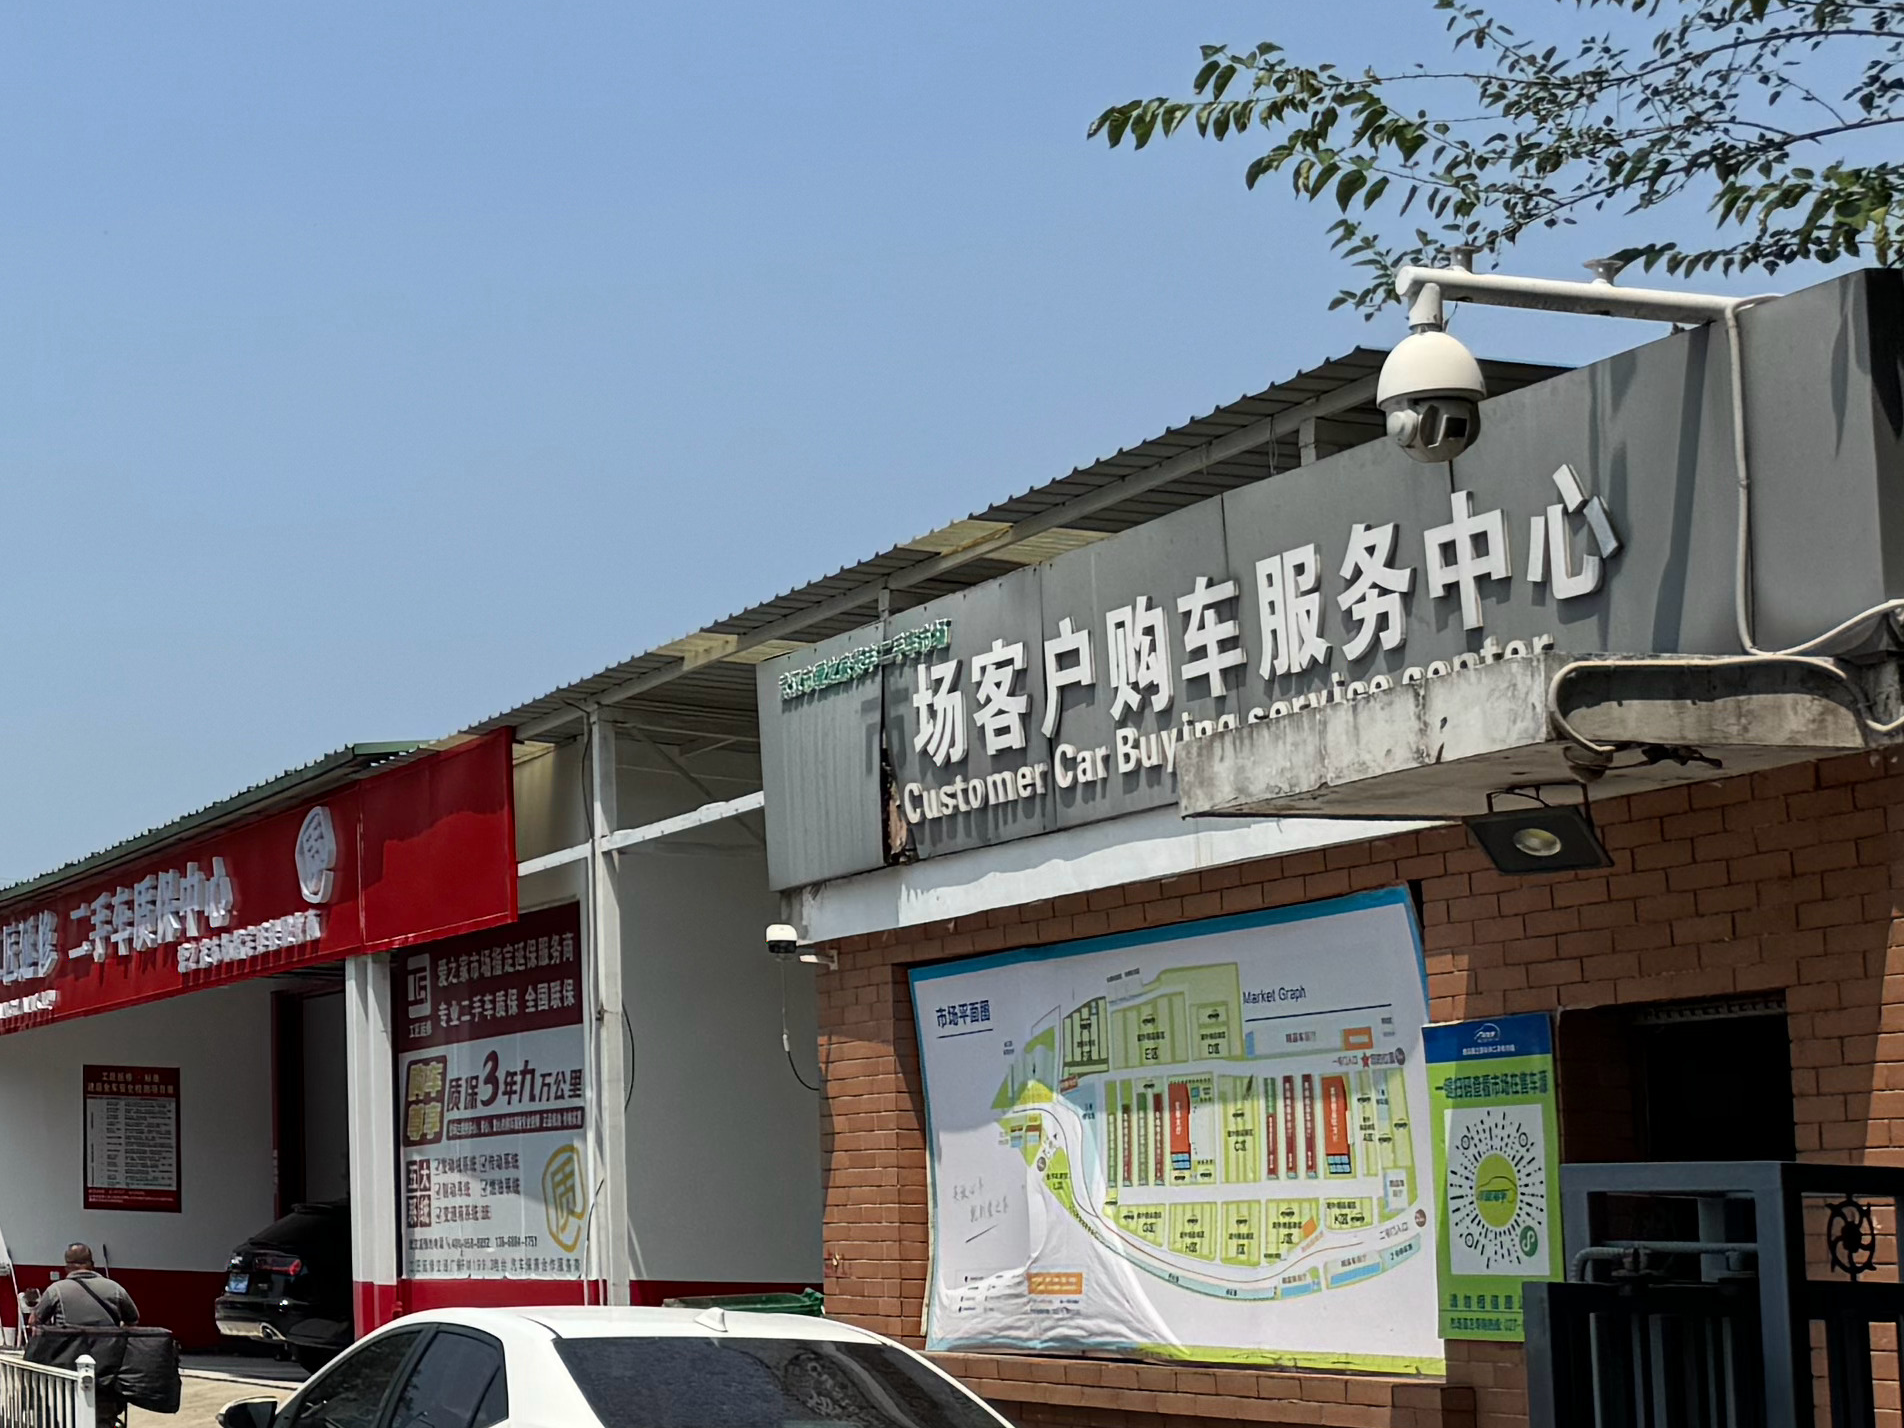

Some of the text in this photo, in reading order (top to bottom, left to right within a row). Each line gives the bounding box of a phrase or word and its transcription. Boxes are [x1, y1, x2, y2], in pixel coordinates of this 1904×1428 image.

[912, 463, 1624, 767] 场客户购车服务中心
[903, 762, 1048, 824] Customer
[1054, 743, 1110, 789] Car
[68, 856, 234, 963] 二手车质保中心
[1243, 984, 1307, 1004] Market Graph
